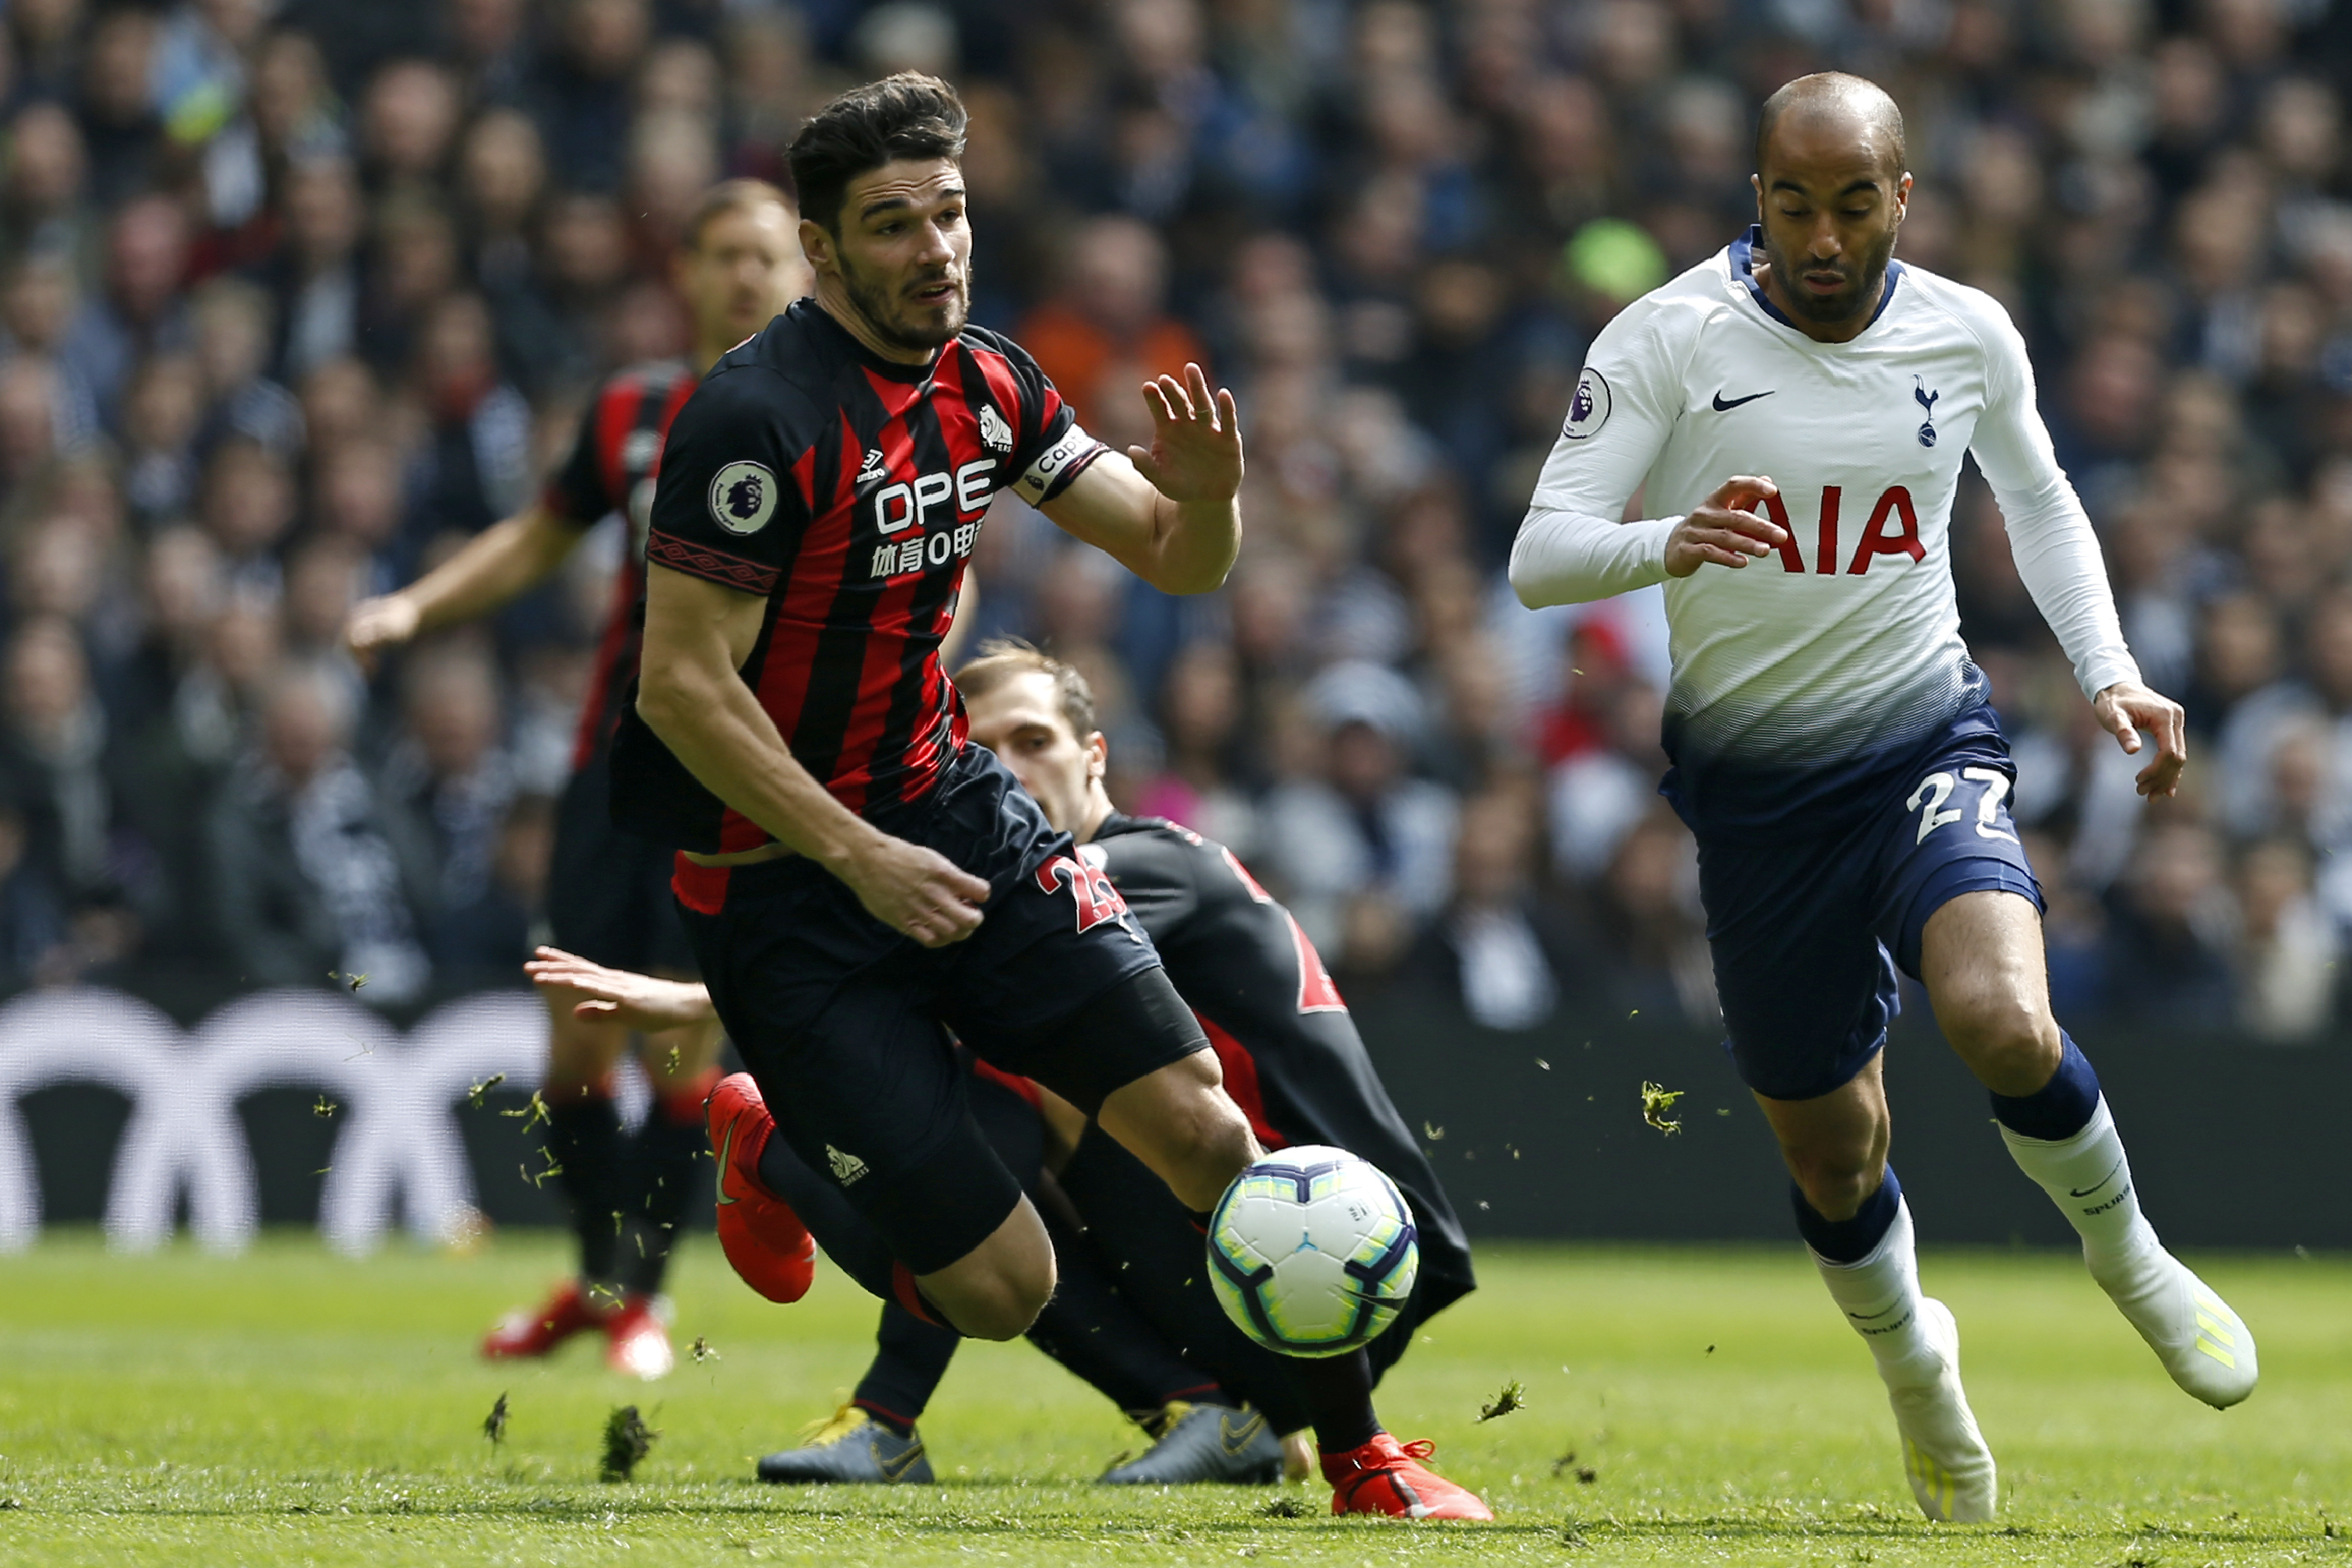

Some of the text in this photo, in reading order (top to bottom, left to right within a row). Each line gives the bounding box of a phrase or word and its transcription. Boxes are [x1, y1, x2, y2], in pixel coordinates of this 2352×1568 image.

[875, 459, 996, 535] OPE
[1730, 485, 1926, 575] AIA
[1906, 767, 2011, 846] 27
[2082, 1182, 2130, 1216] SPURS
